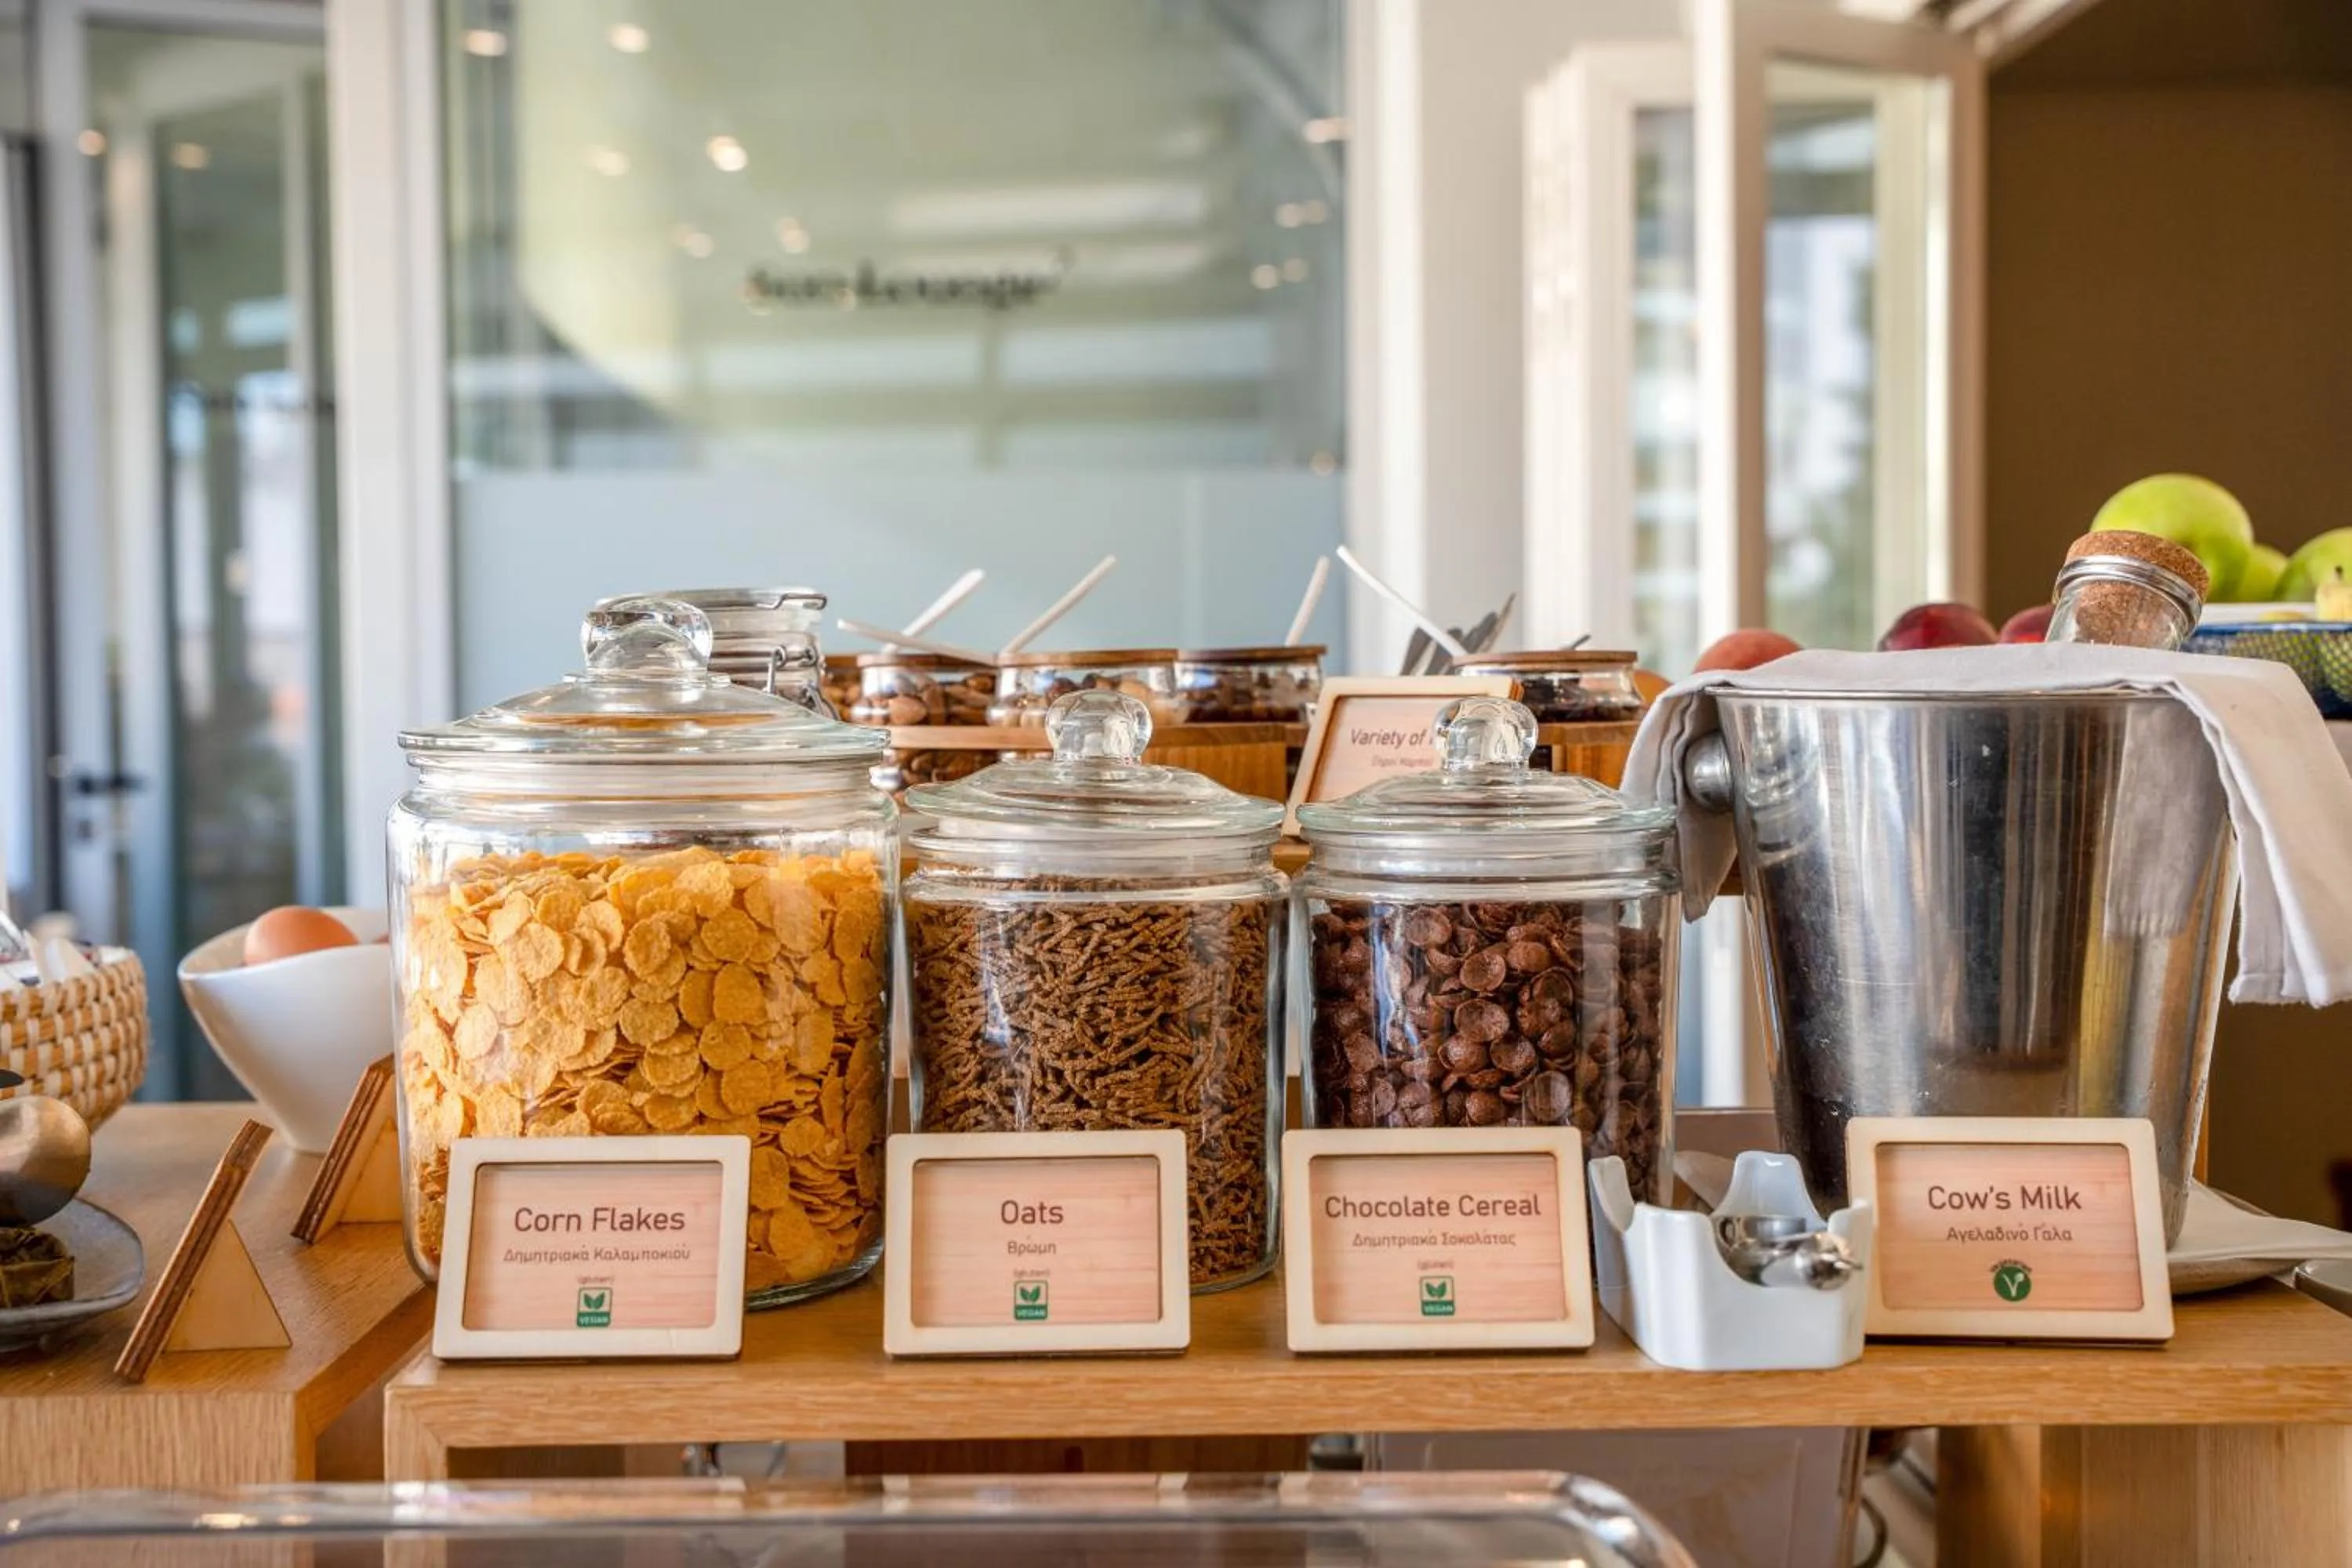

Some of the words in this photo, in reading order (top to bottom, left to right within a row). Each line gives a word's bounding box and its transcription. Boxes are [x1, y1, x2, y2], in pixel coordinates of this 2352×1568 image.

[1350, 728, 1406, 750] Variety
[1408, 728, 1428, 746] of
[1323, 1195, 1450, 1218] Chocolate
[1457, 1193, 1542, 1217] Cereal
[1927, 1185, 2012, 1210] Cow's
[2020, 1185, 2082, 1210] Milk
[514, 1207, 583, 1233] Corn
[591, 1207, 686, 1232] Flakes
[1000, 1200, 1065, 1225] Oats
[1007, 1235, 1057, 1257] Βρώμη
